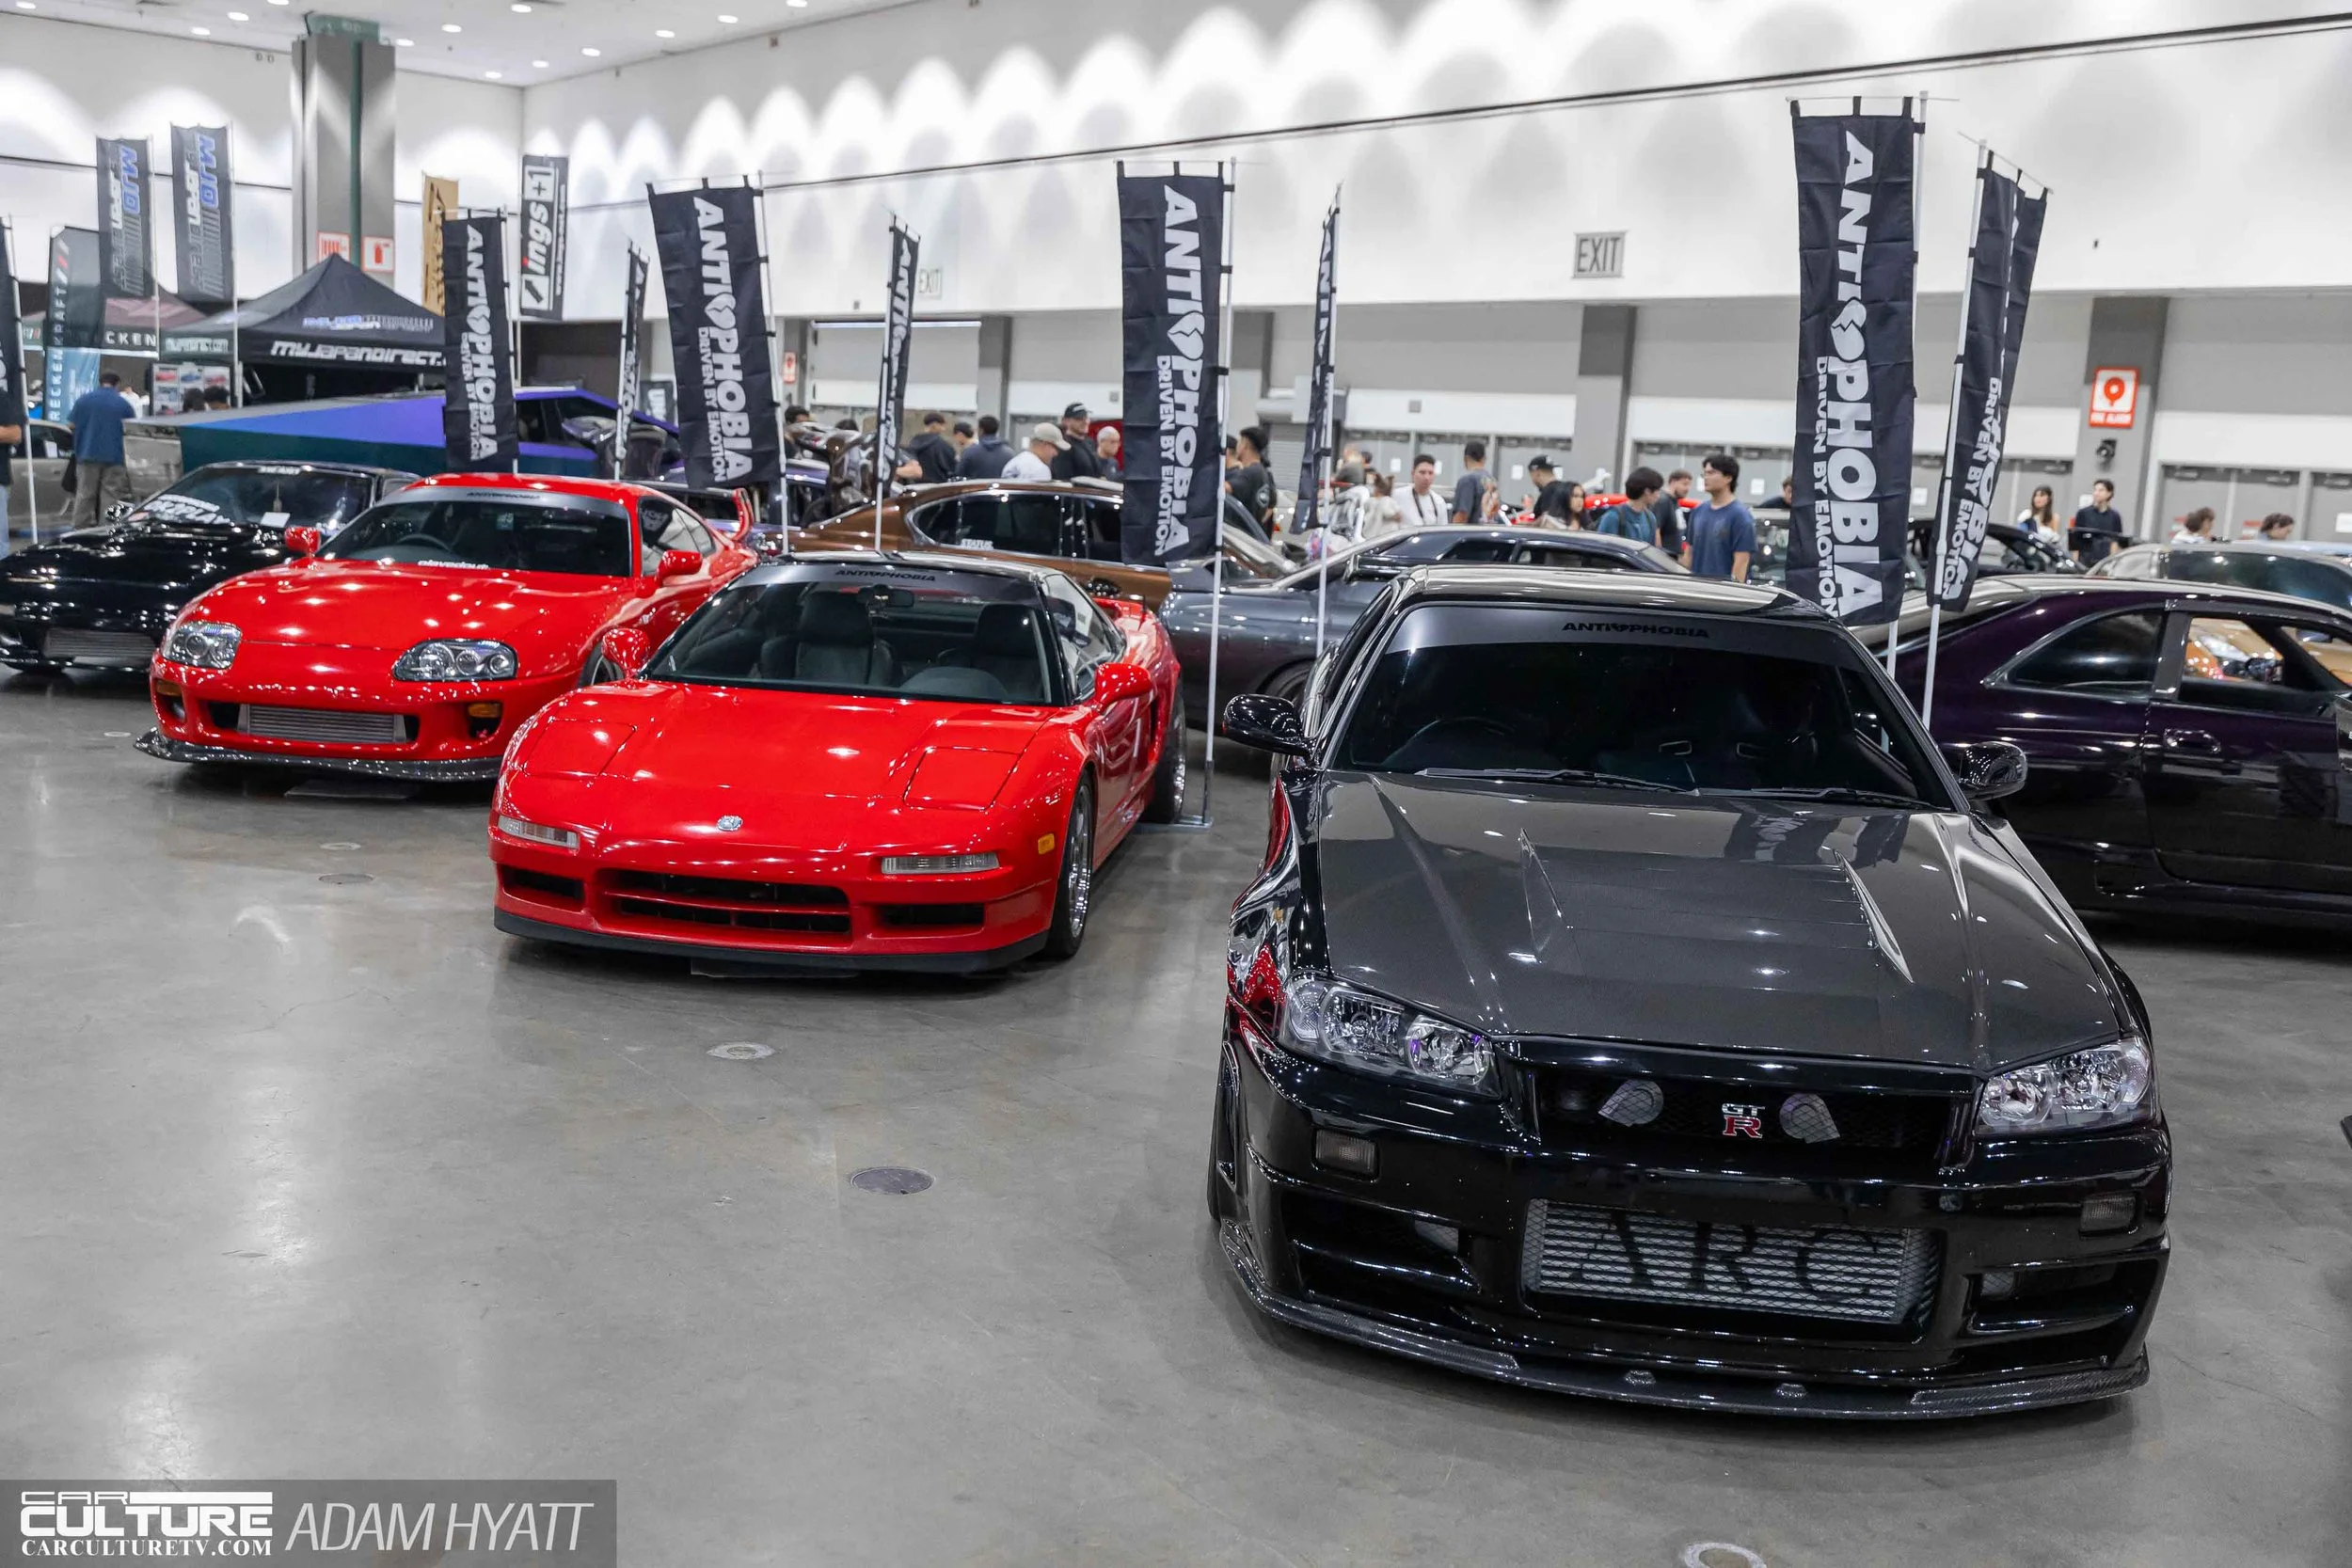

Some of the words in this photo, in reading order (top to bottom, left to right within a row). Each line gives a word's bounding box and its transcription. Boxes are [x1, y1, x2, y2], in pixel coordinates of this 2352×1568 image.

[1577, 237, 1620, 272] EXIT
[698, 326, 714, 385] DRIVEN
[704, 388, 717, 408] BY
[1157, 356, 1174, 431] DRIVEN
[1814, 356, 1829, 453] DRIVEN
[1971, 377, 2001, 462] DRIVEN
[707, 411, 728, 483] EMOTION
[1160, 436, 1174, 459] BY
[1812, 460, 1828, 495] BY
[1964, 466, 1981, 498] BY
[1154, 465, 1174, 556] EMOTION
[1814, 499, 1841, 618] EMOTION
[1568, 1212, 1878, 1300] ARC
